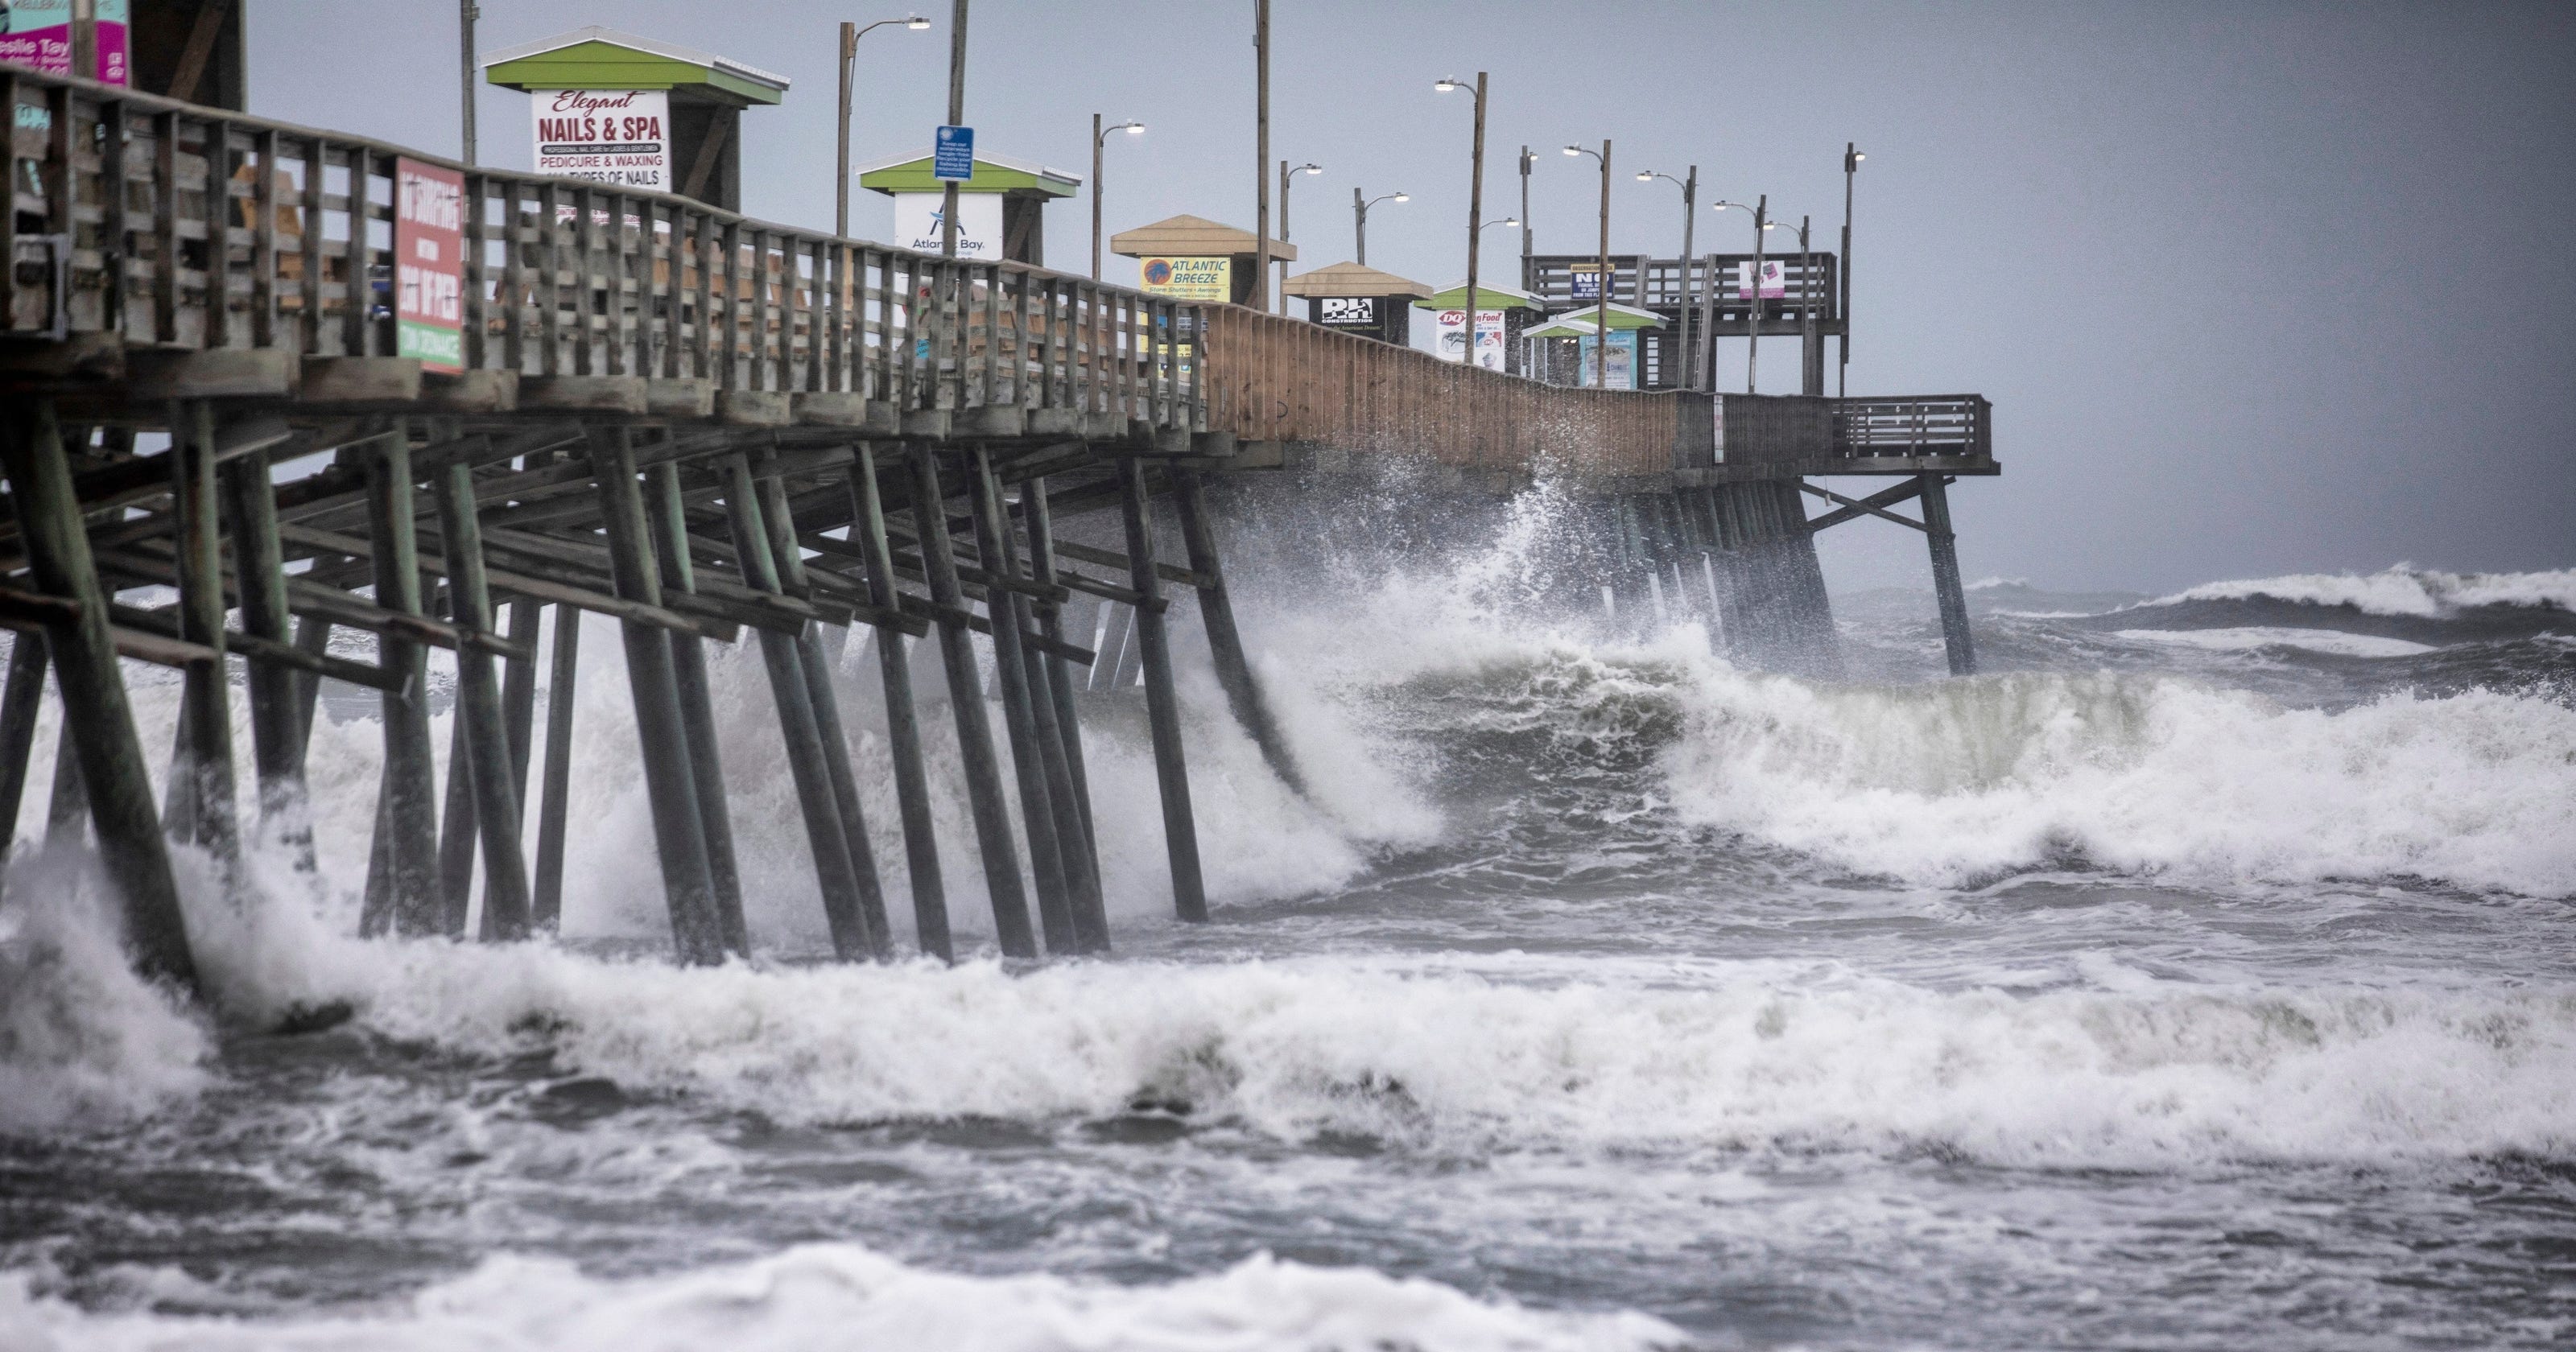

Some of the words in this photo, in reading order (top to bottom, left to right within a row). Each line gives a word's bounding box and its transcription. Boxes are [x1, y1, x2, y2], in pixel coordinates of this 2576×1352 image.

[0, 37, 37, 55] eslie
[38, 38, 71, 58] Tay
[552, 90, 646, 117] Elegant
[539, 117, 597, 142] NAILS
[603, 117, 617, 141] &
[623, 116, 662, 140] SPA
[540, 156, 601, 167] PEDICURE
[604, 156, 612, 167] &
[616, 155, 663, 166] WAXING
[608, 171, 623, 185] OF
[626, 170, 659, 185] NAILS
[912, 238, 957, 248] Atlan
[960, 239, 983, 251] Bay
[1171, 261, 1227, 271] ATLANTIC
[1174, 274, 1218, 283] BREEZE
[1575, 273, 1610, 282] NO
[1443, 314, 1462, 324] DQ
[1482, 313, 1502, 323] Food
